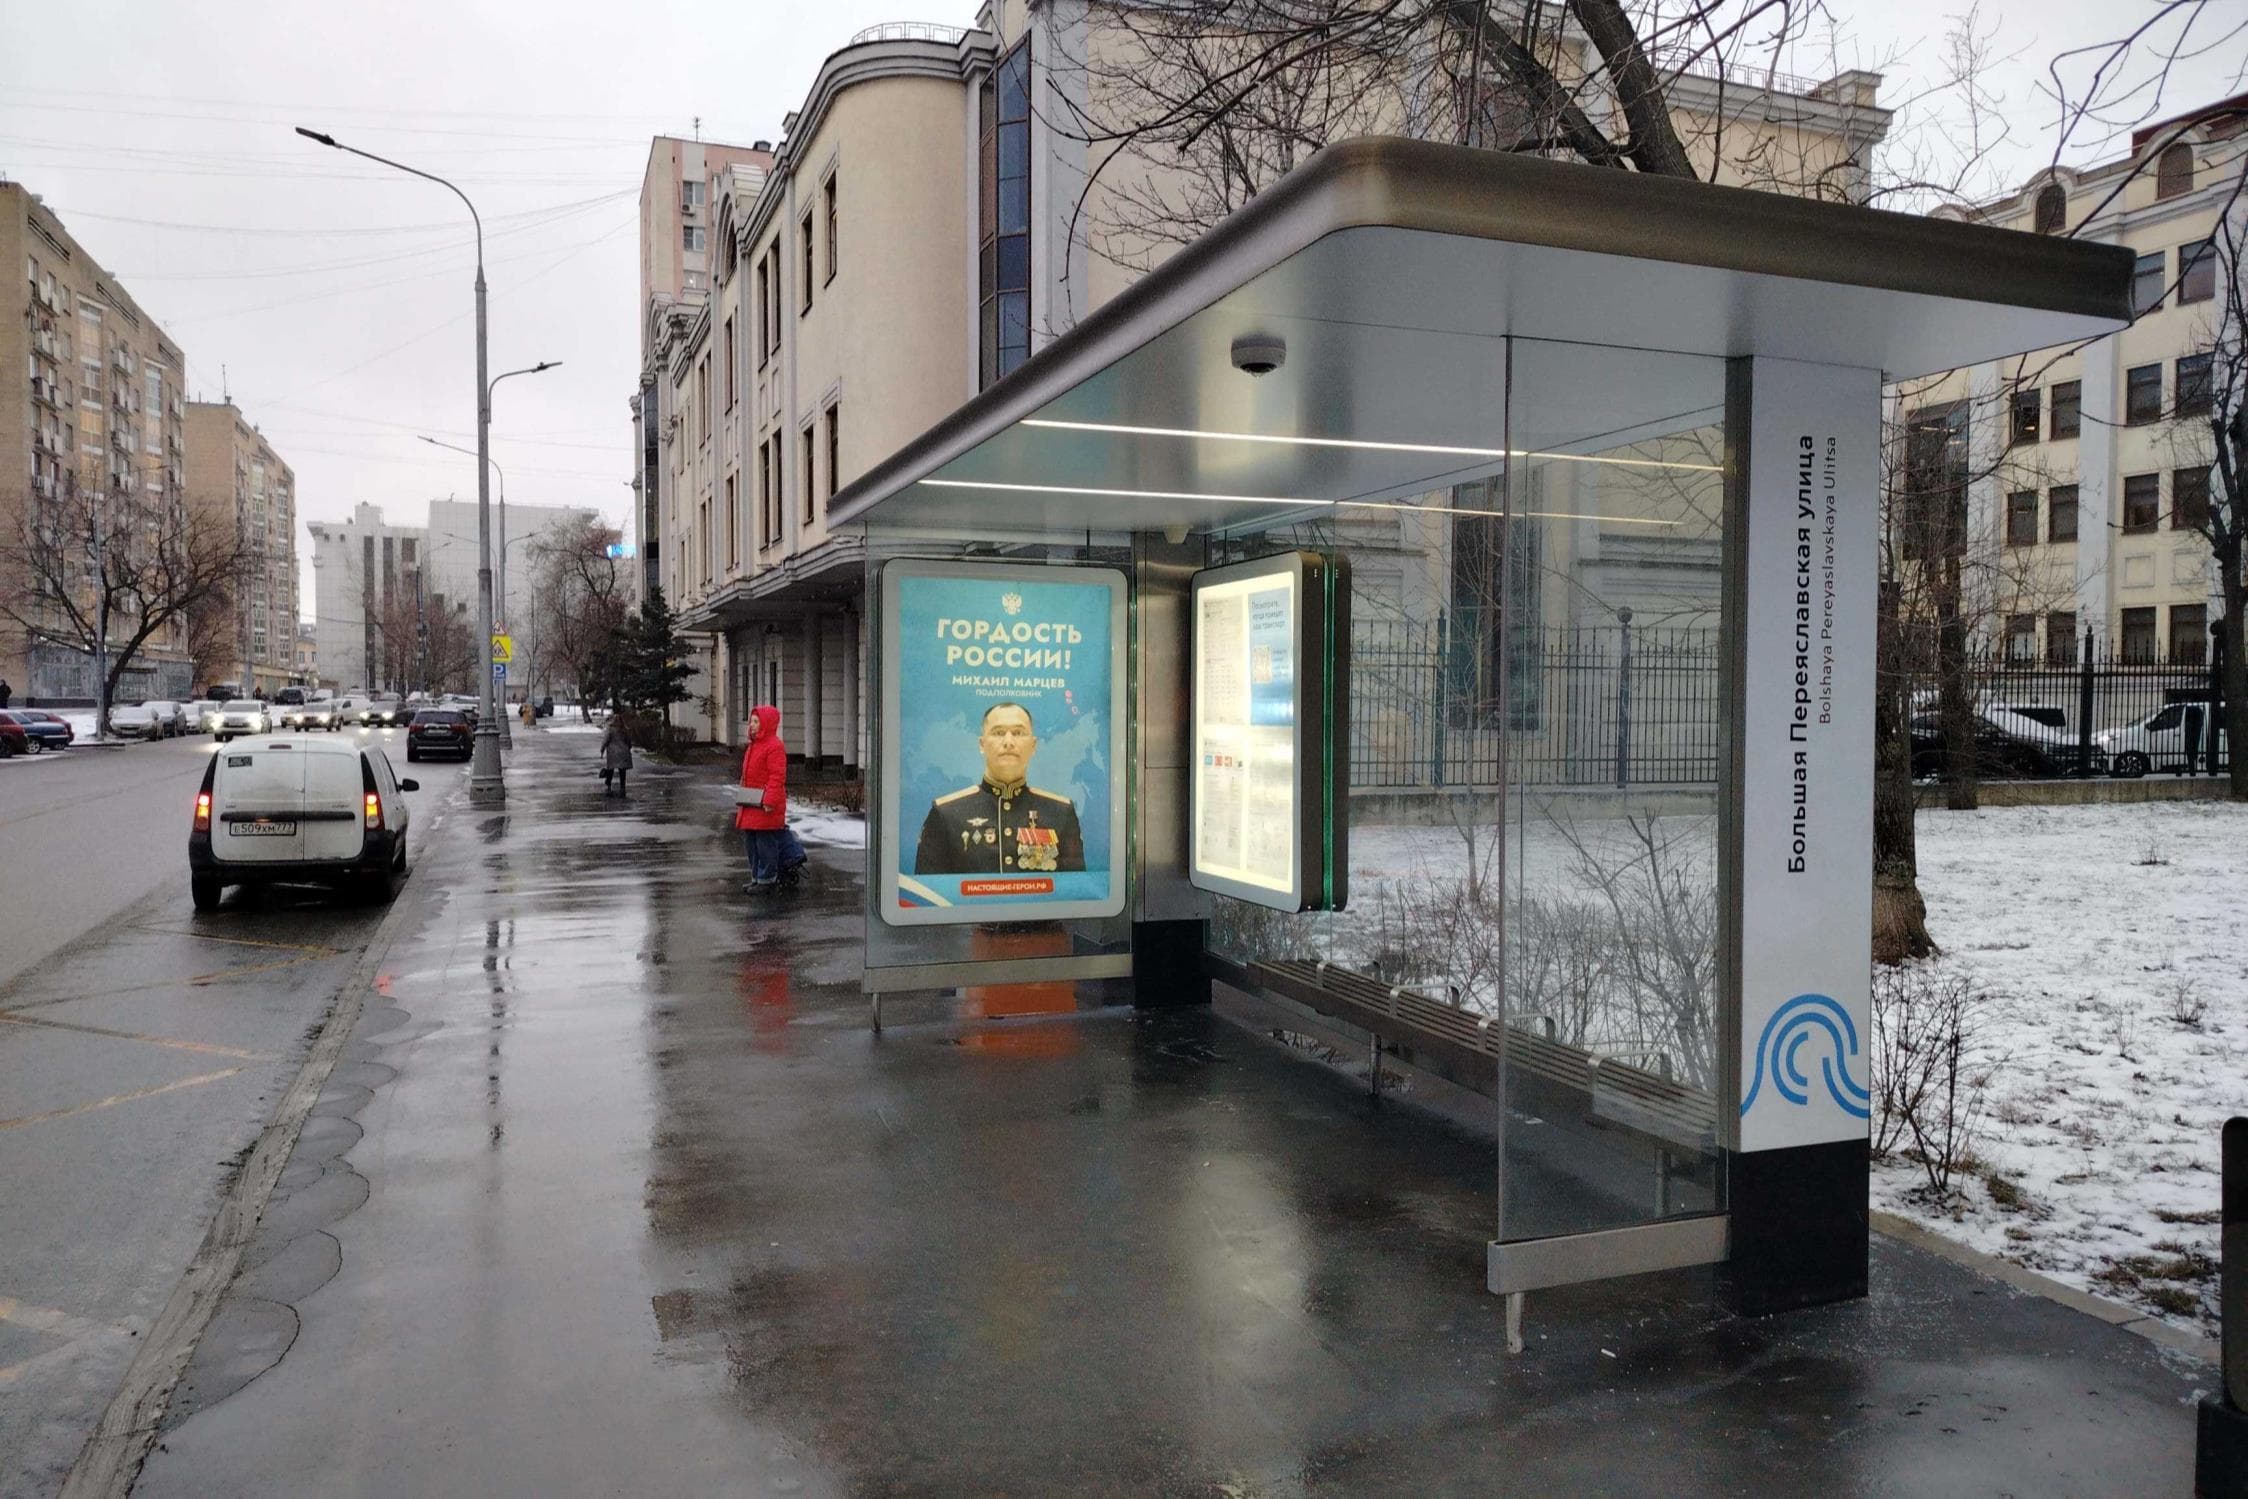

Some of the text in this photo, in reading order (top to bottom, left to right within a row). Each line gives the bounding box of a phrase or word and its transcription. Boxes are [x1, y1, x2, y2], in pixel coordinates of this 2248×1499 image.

[1819, 436, 1837, 724] Bolshaya Pereyaslavskaya Ulitsa
[937, 618, 1082, 644] ГОРДОСТЬ
[946, 645, 1072, 670] РОССИИ!
[1788, 435, 1815, 873] Большая Переяславская улица
[952, 675, 1065, 689] МИХАИЛ МАРЦЕВ
[975, 688, 1042, 697] ПОДПОЛКОВНИК
